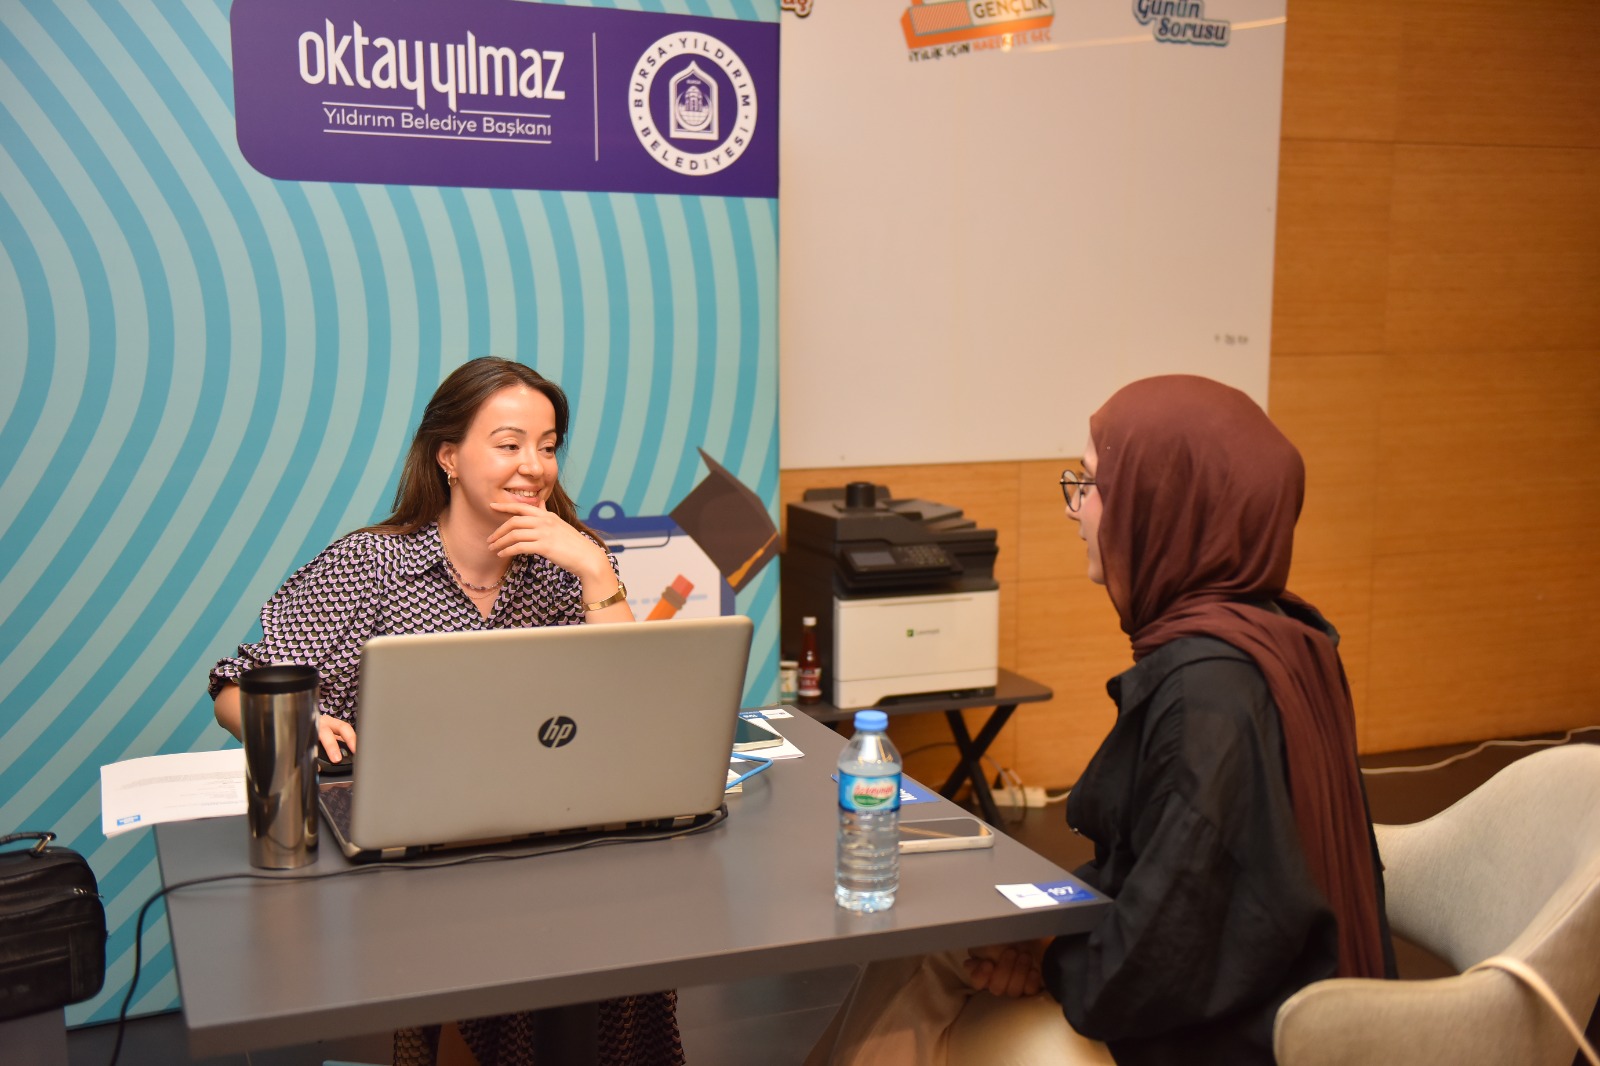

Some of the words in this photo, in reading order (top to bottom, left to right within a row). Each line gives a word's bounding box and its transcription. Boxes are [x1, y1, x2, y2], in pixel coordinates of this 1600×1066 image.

[1158, 18, 1226, 40] Sorusu
[634, 46, 668, 107] BURSA
[679, 37, 750, 106] YILDIRIM
[323, 107, 395, 128] Yıldırım
[401, 112, 477, 135] Belediye
[482, 117, 552, 137] Başkanı
[640, 127, 749, 171] BELEDİYESİ
[542, 715, 574, 749] hp
